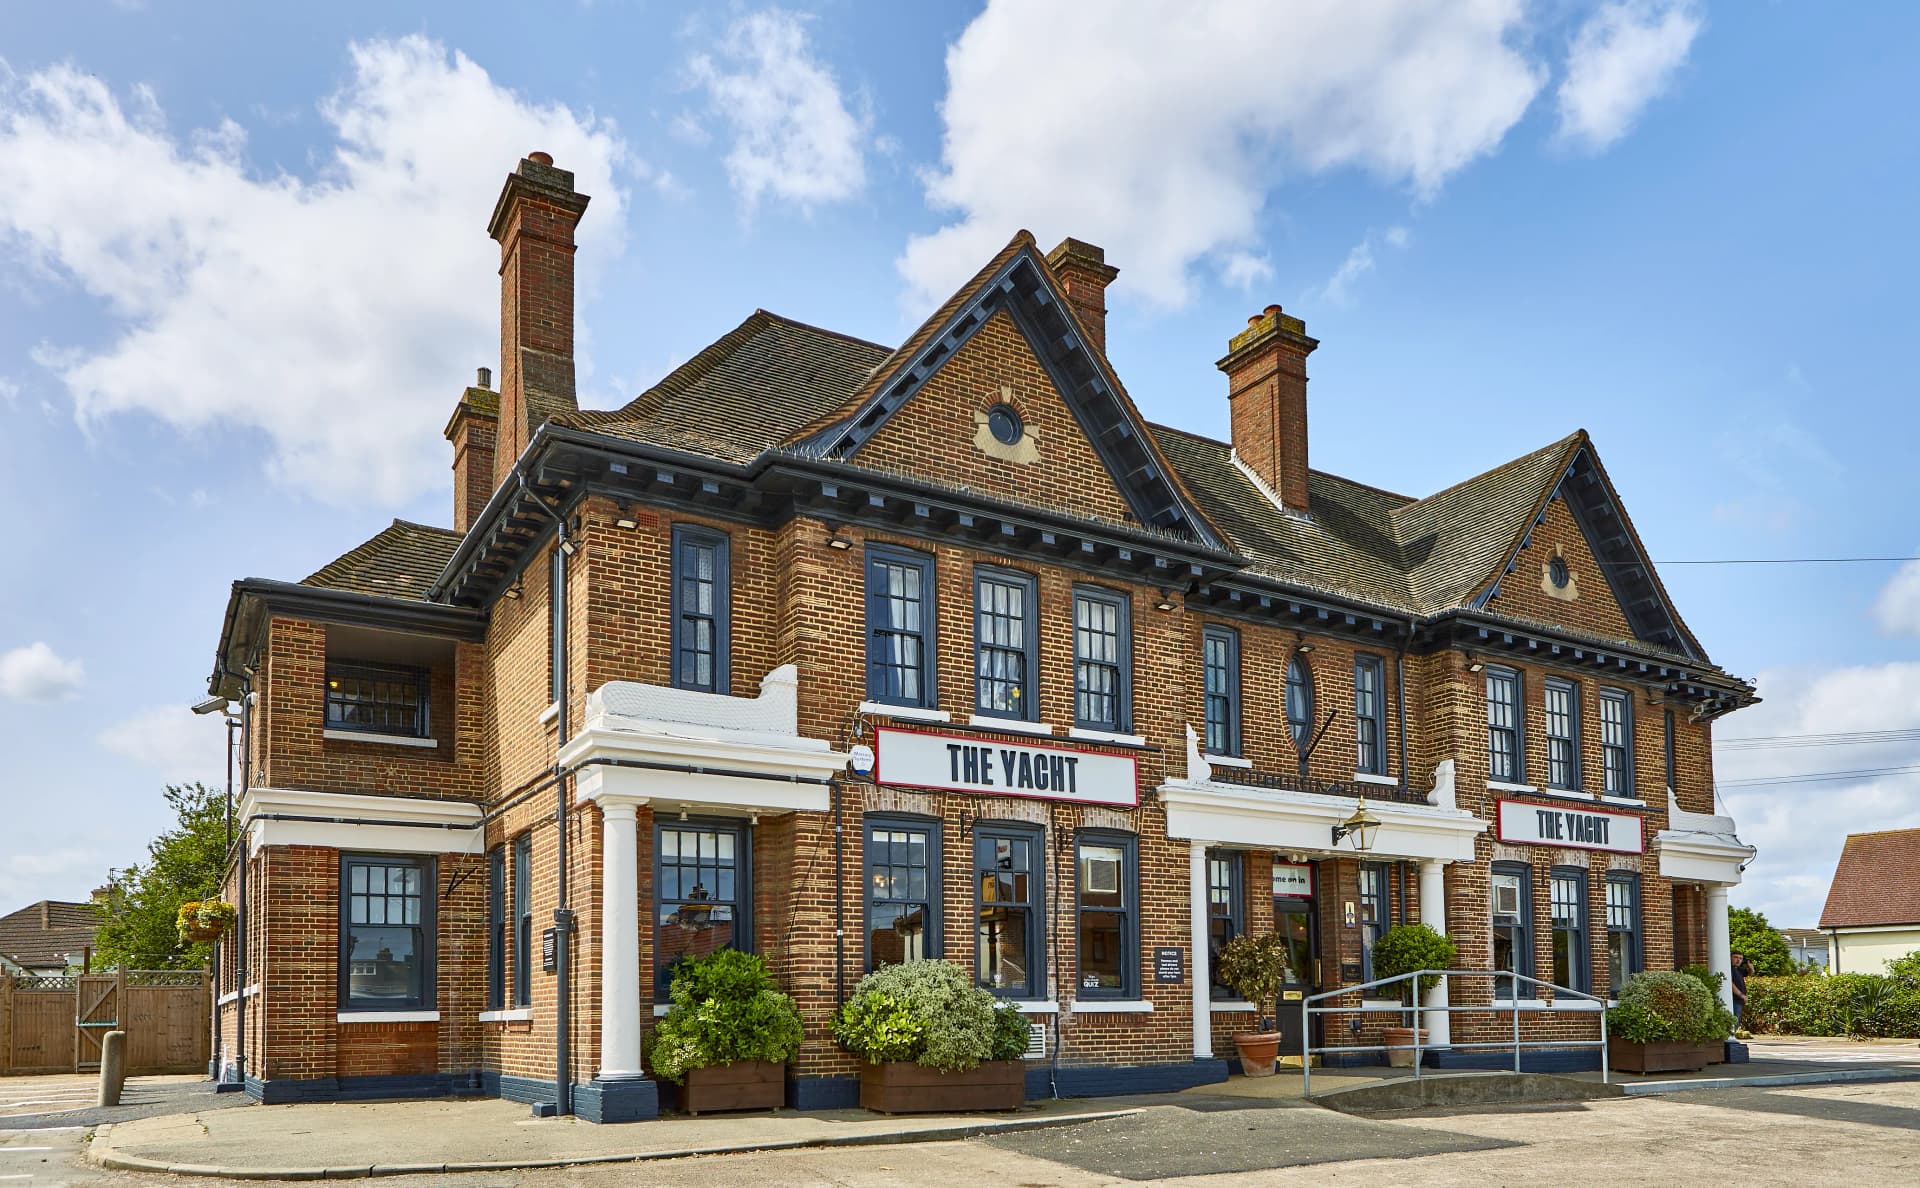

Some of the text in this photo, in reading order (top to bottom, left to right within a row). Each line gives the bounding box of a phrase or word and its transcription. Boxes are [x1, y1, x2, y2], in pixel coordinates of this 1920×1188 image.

[947, 743, 1079, 793] THE YACHT
[1536, 810, 1610, 845] THE YACHT
[1298, 875, 1306, 884] in
